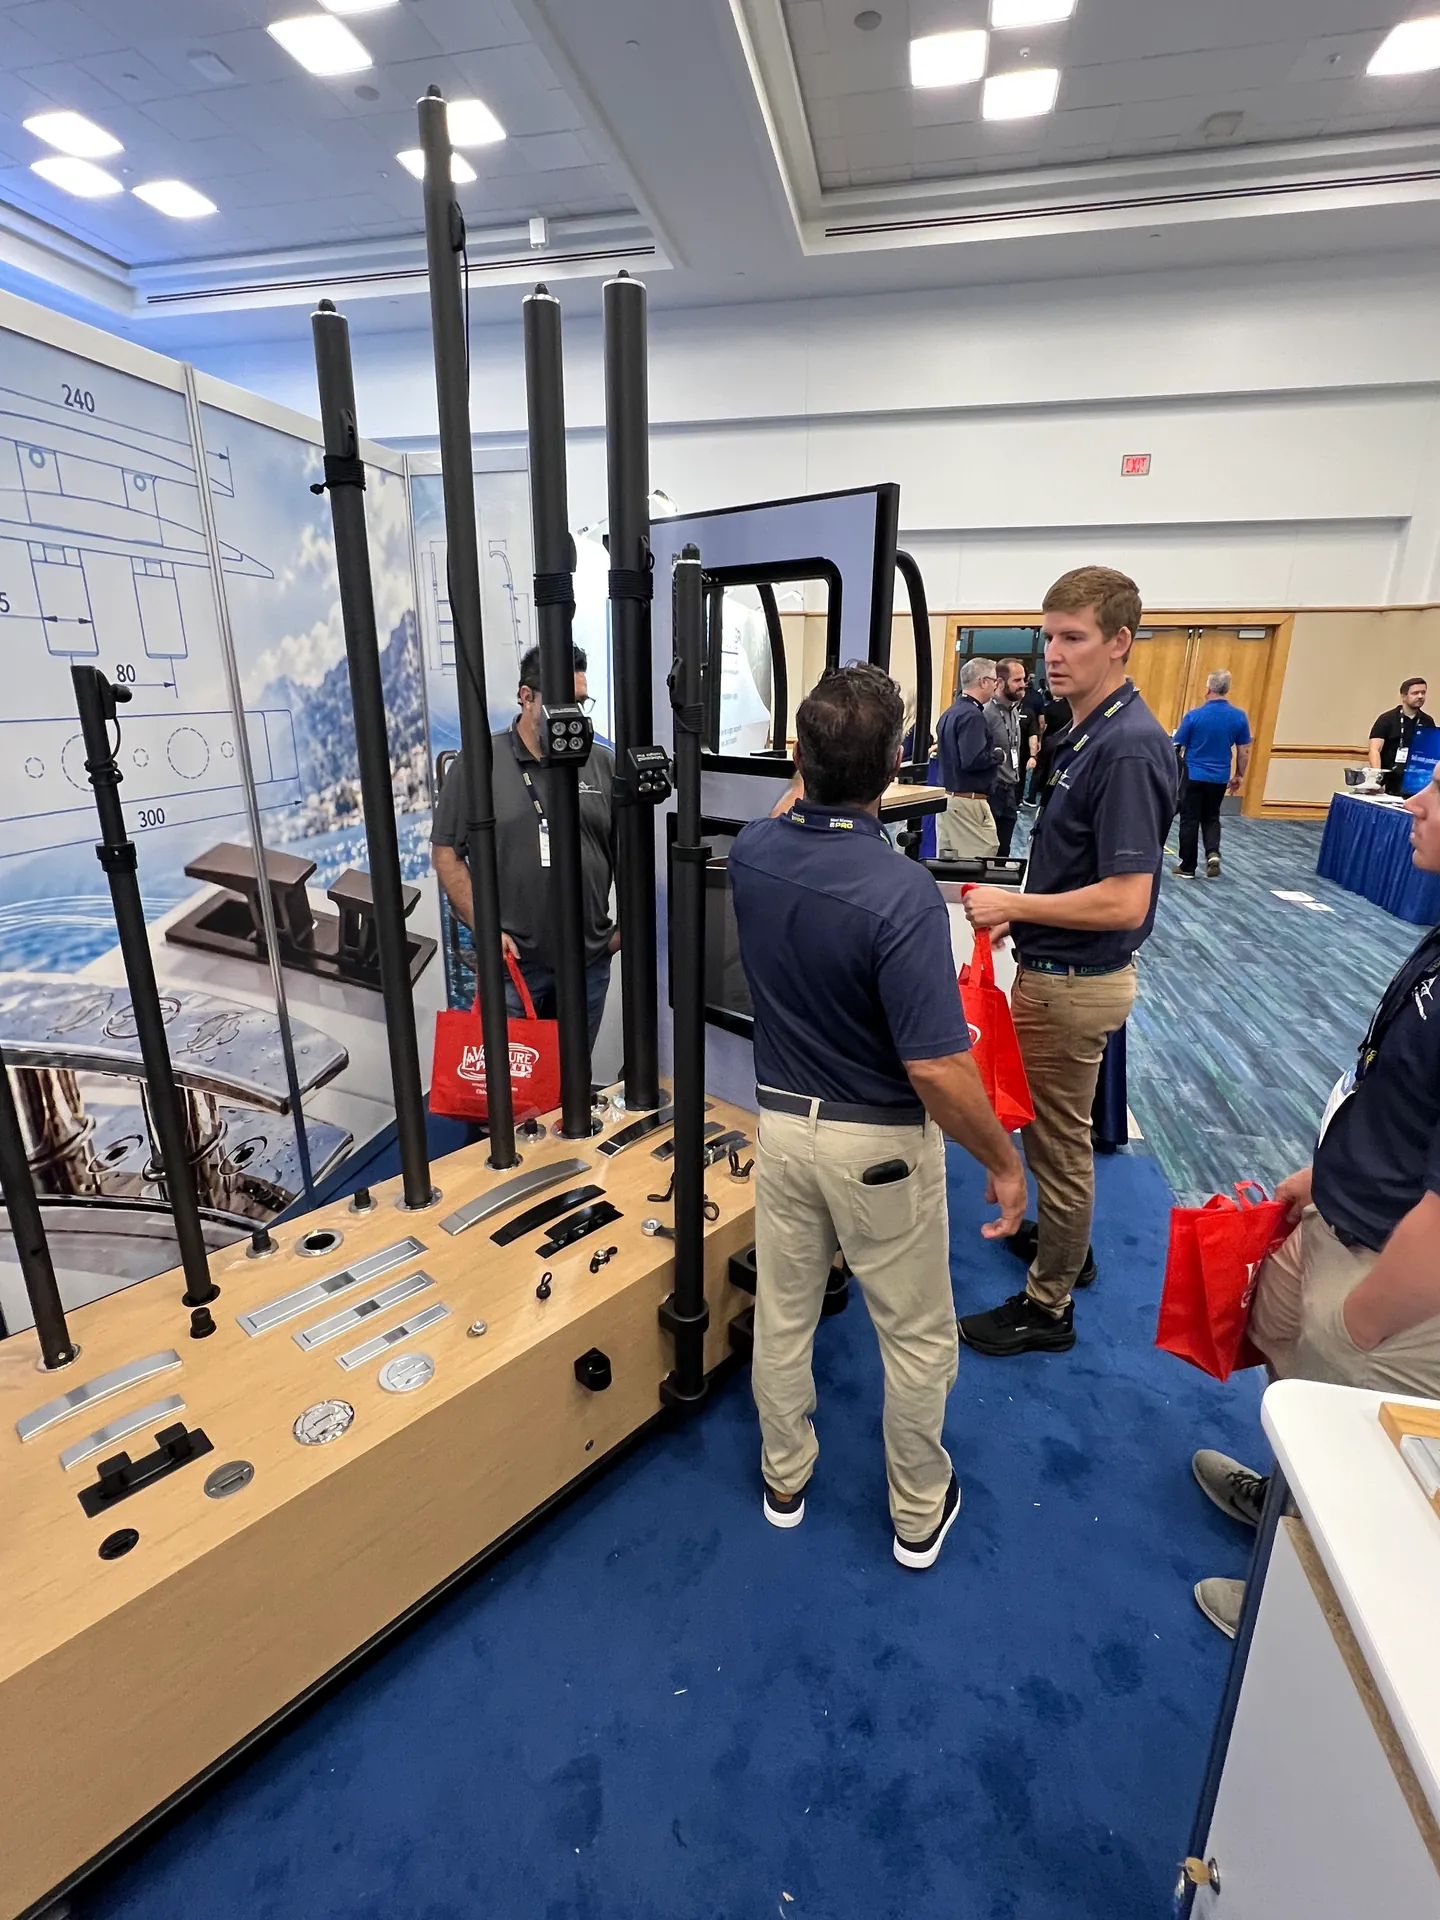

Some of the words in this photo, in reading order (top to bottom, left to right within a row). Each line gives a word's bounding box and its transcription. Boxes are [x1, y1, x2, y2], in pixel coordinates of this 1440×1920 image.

[61, 383, 95, 413] 240
[1125, 456, 1148, 473] EXIT
[116, 664, 135, 682] 80
[138, 808, 165, 828] 300
[461, 1045, 532, 1070] LAVAURE
[475, 1060, 533, 1074] PCTS
